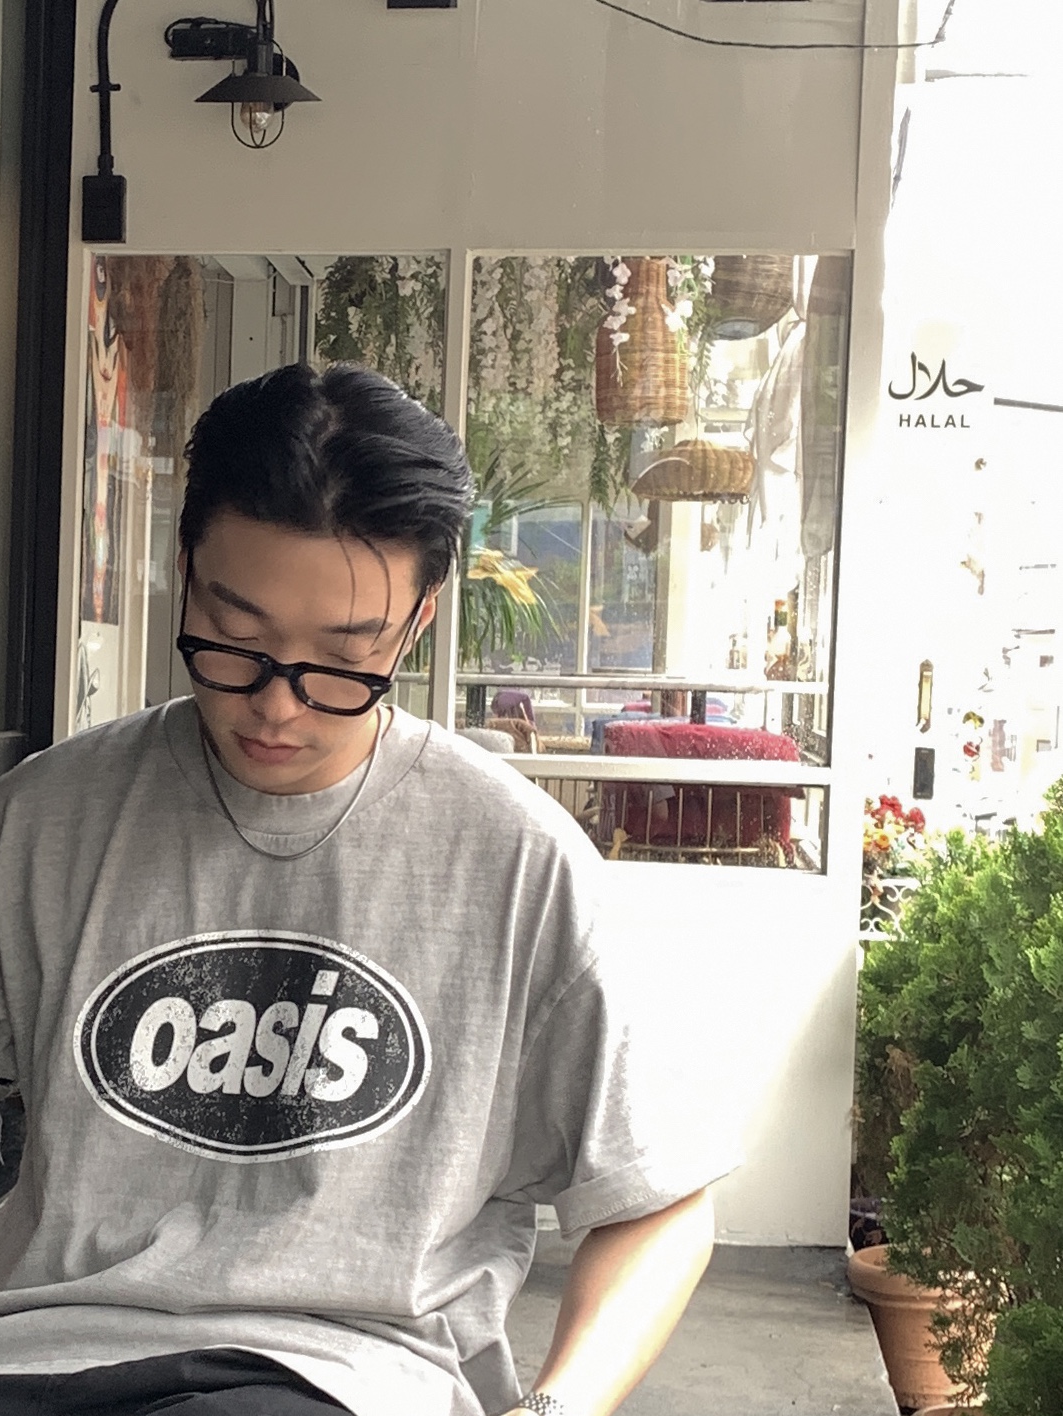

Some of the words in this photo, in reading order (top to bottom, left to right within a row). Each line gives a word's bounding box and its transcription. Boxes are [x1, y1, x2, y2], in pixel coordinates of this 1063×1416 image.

[888, 351, 985, 401] حلال
[899, 413, 970, 428] HALAL
[130, 969, 379, 1102] oasis
